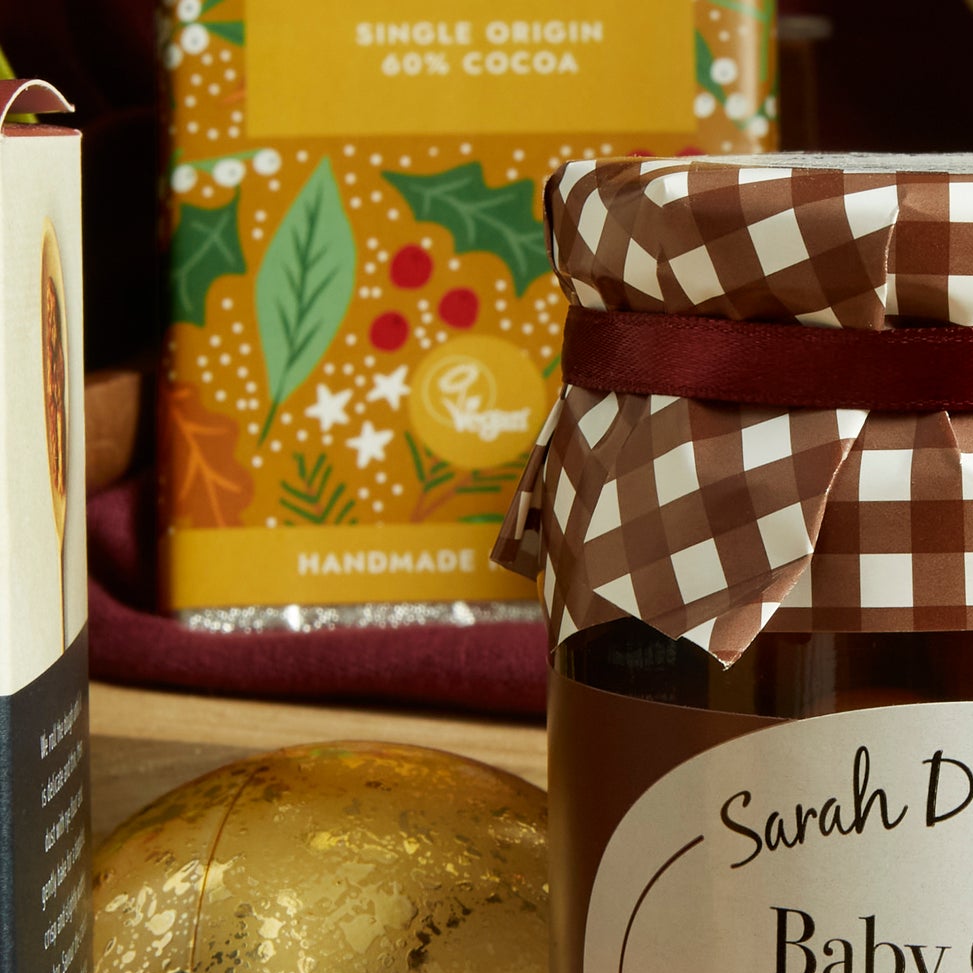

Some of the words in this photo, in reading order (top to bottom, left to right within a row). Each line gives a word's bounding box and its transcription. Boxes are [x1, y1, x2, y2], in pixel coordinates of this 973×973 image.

[356, 21, 472, 46] SINGLE
[486, 20, 604, 45] ORIGIN
[381, 52, 450, 76] 60%
[462, 50, 579, 75] COCOA
[298, 549, 475, 576] HANDMADE
[720, 746, 907, 869] Sarah
